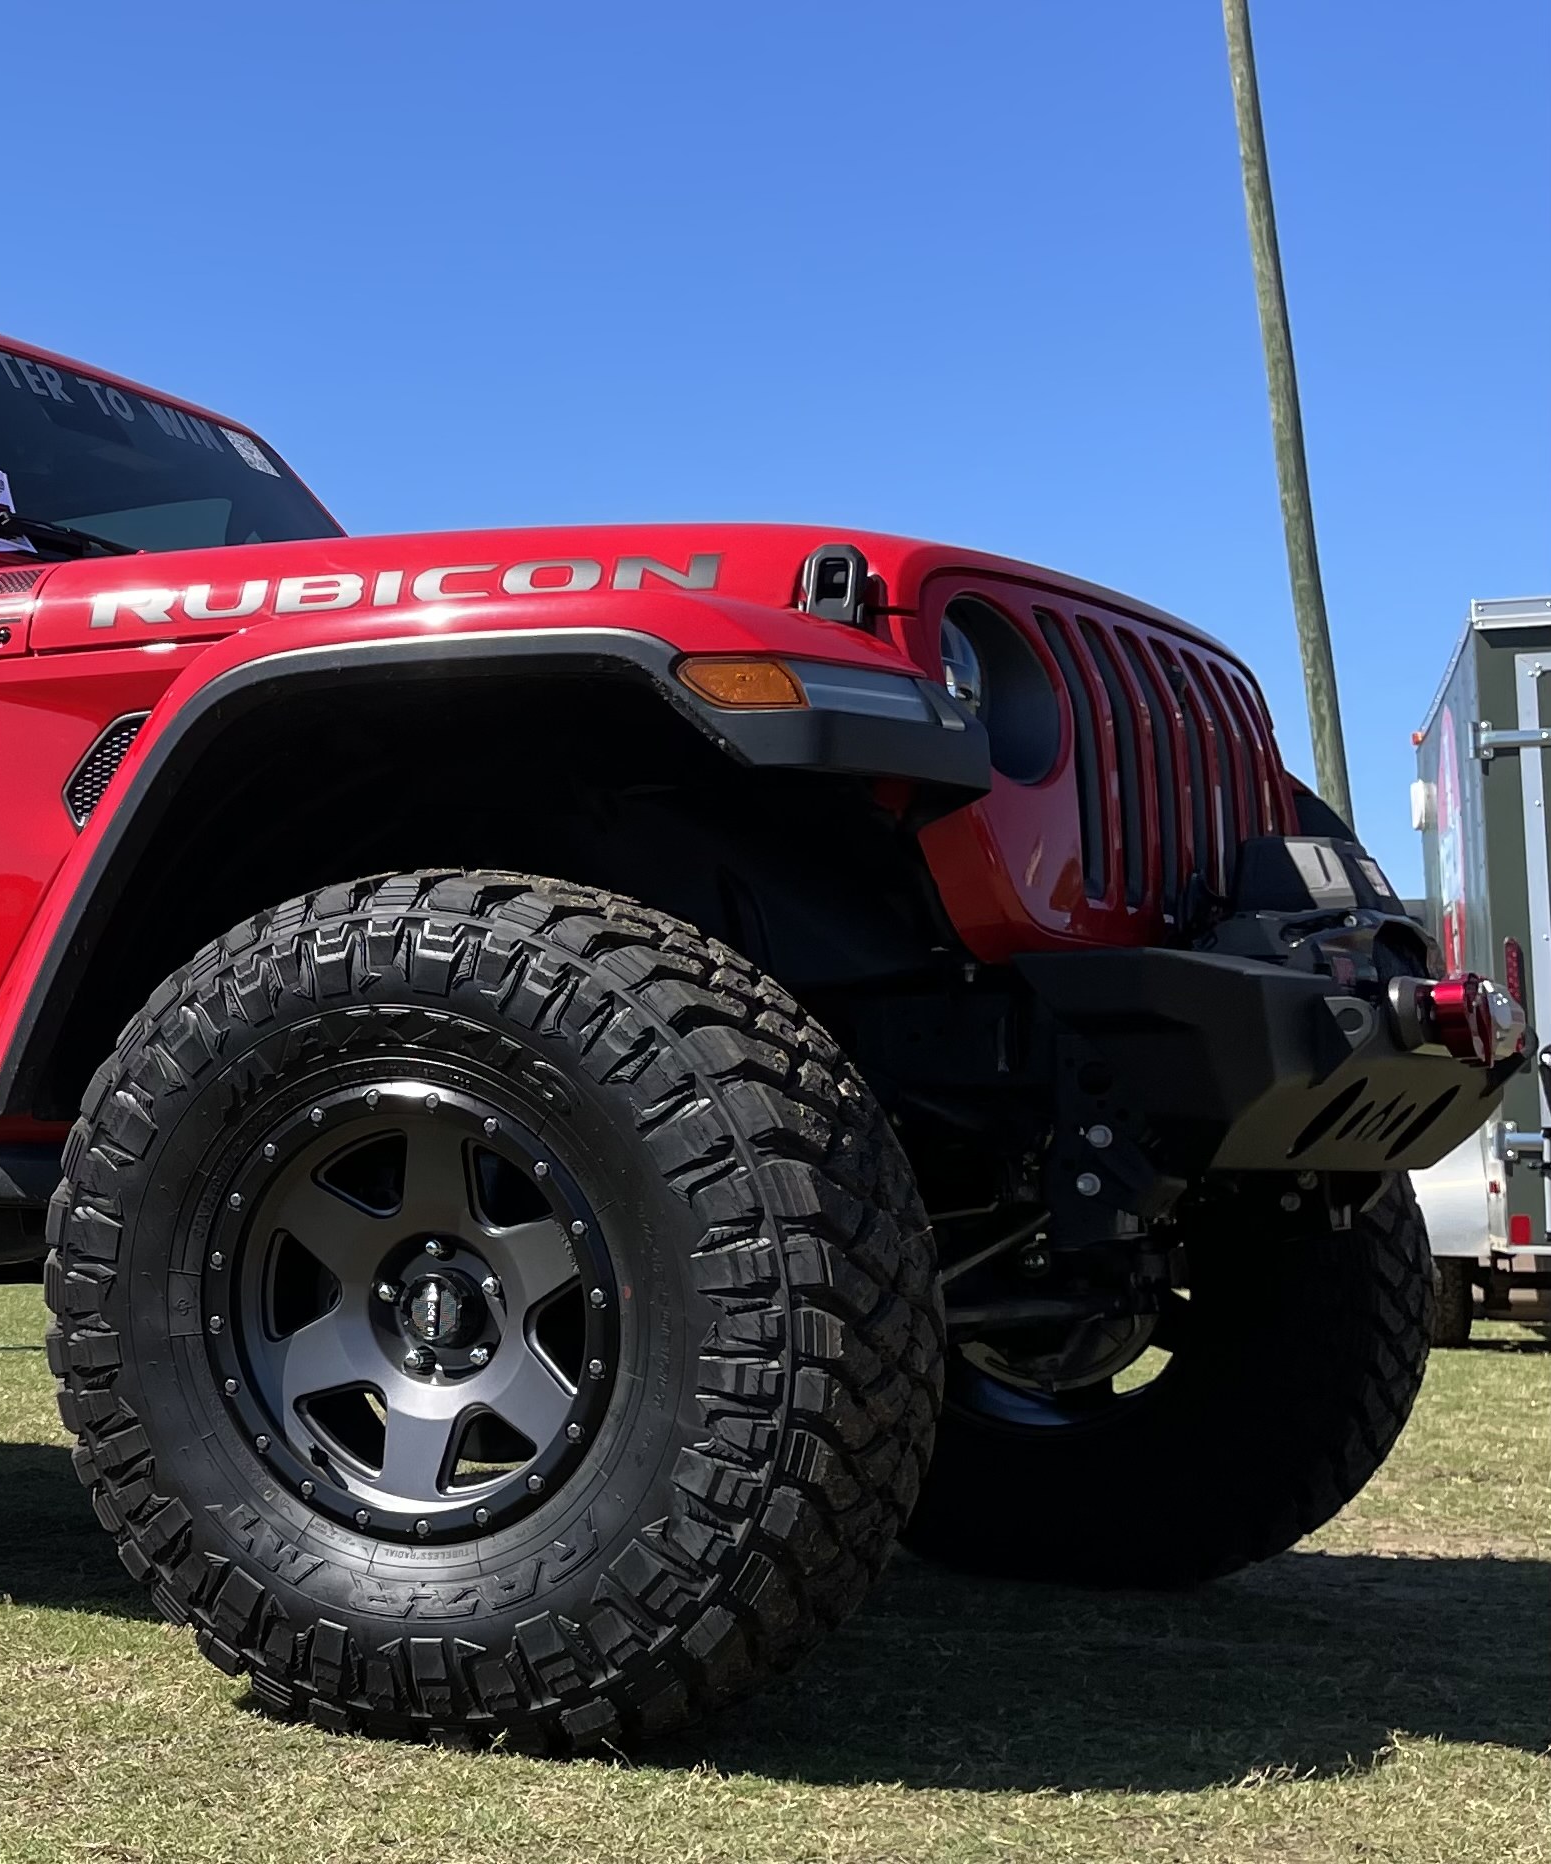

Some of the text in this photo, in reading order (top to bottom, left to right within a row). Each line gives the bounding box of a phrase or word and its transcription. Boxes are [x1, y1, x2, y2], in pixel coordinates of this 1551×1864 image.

[76, 377, 136, 422] TO
[140, 399, 225, 452] WIN
[89, 553, 724, 629] RUBICON
